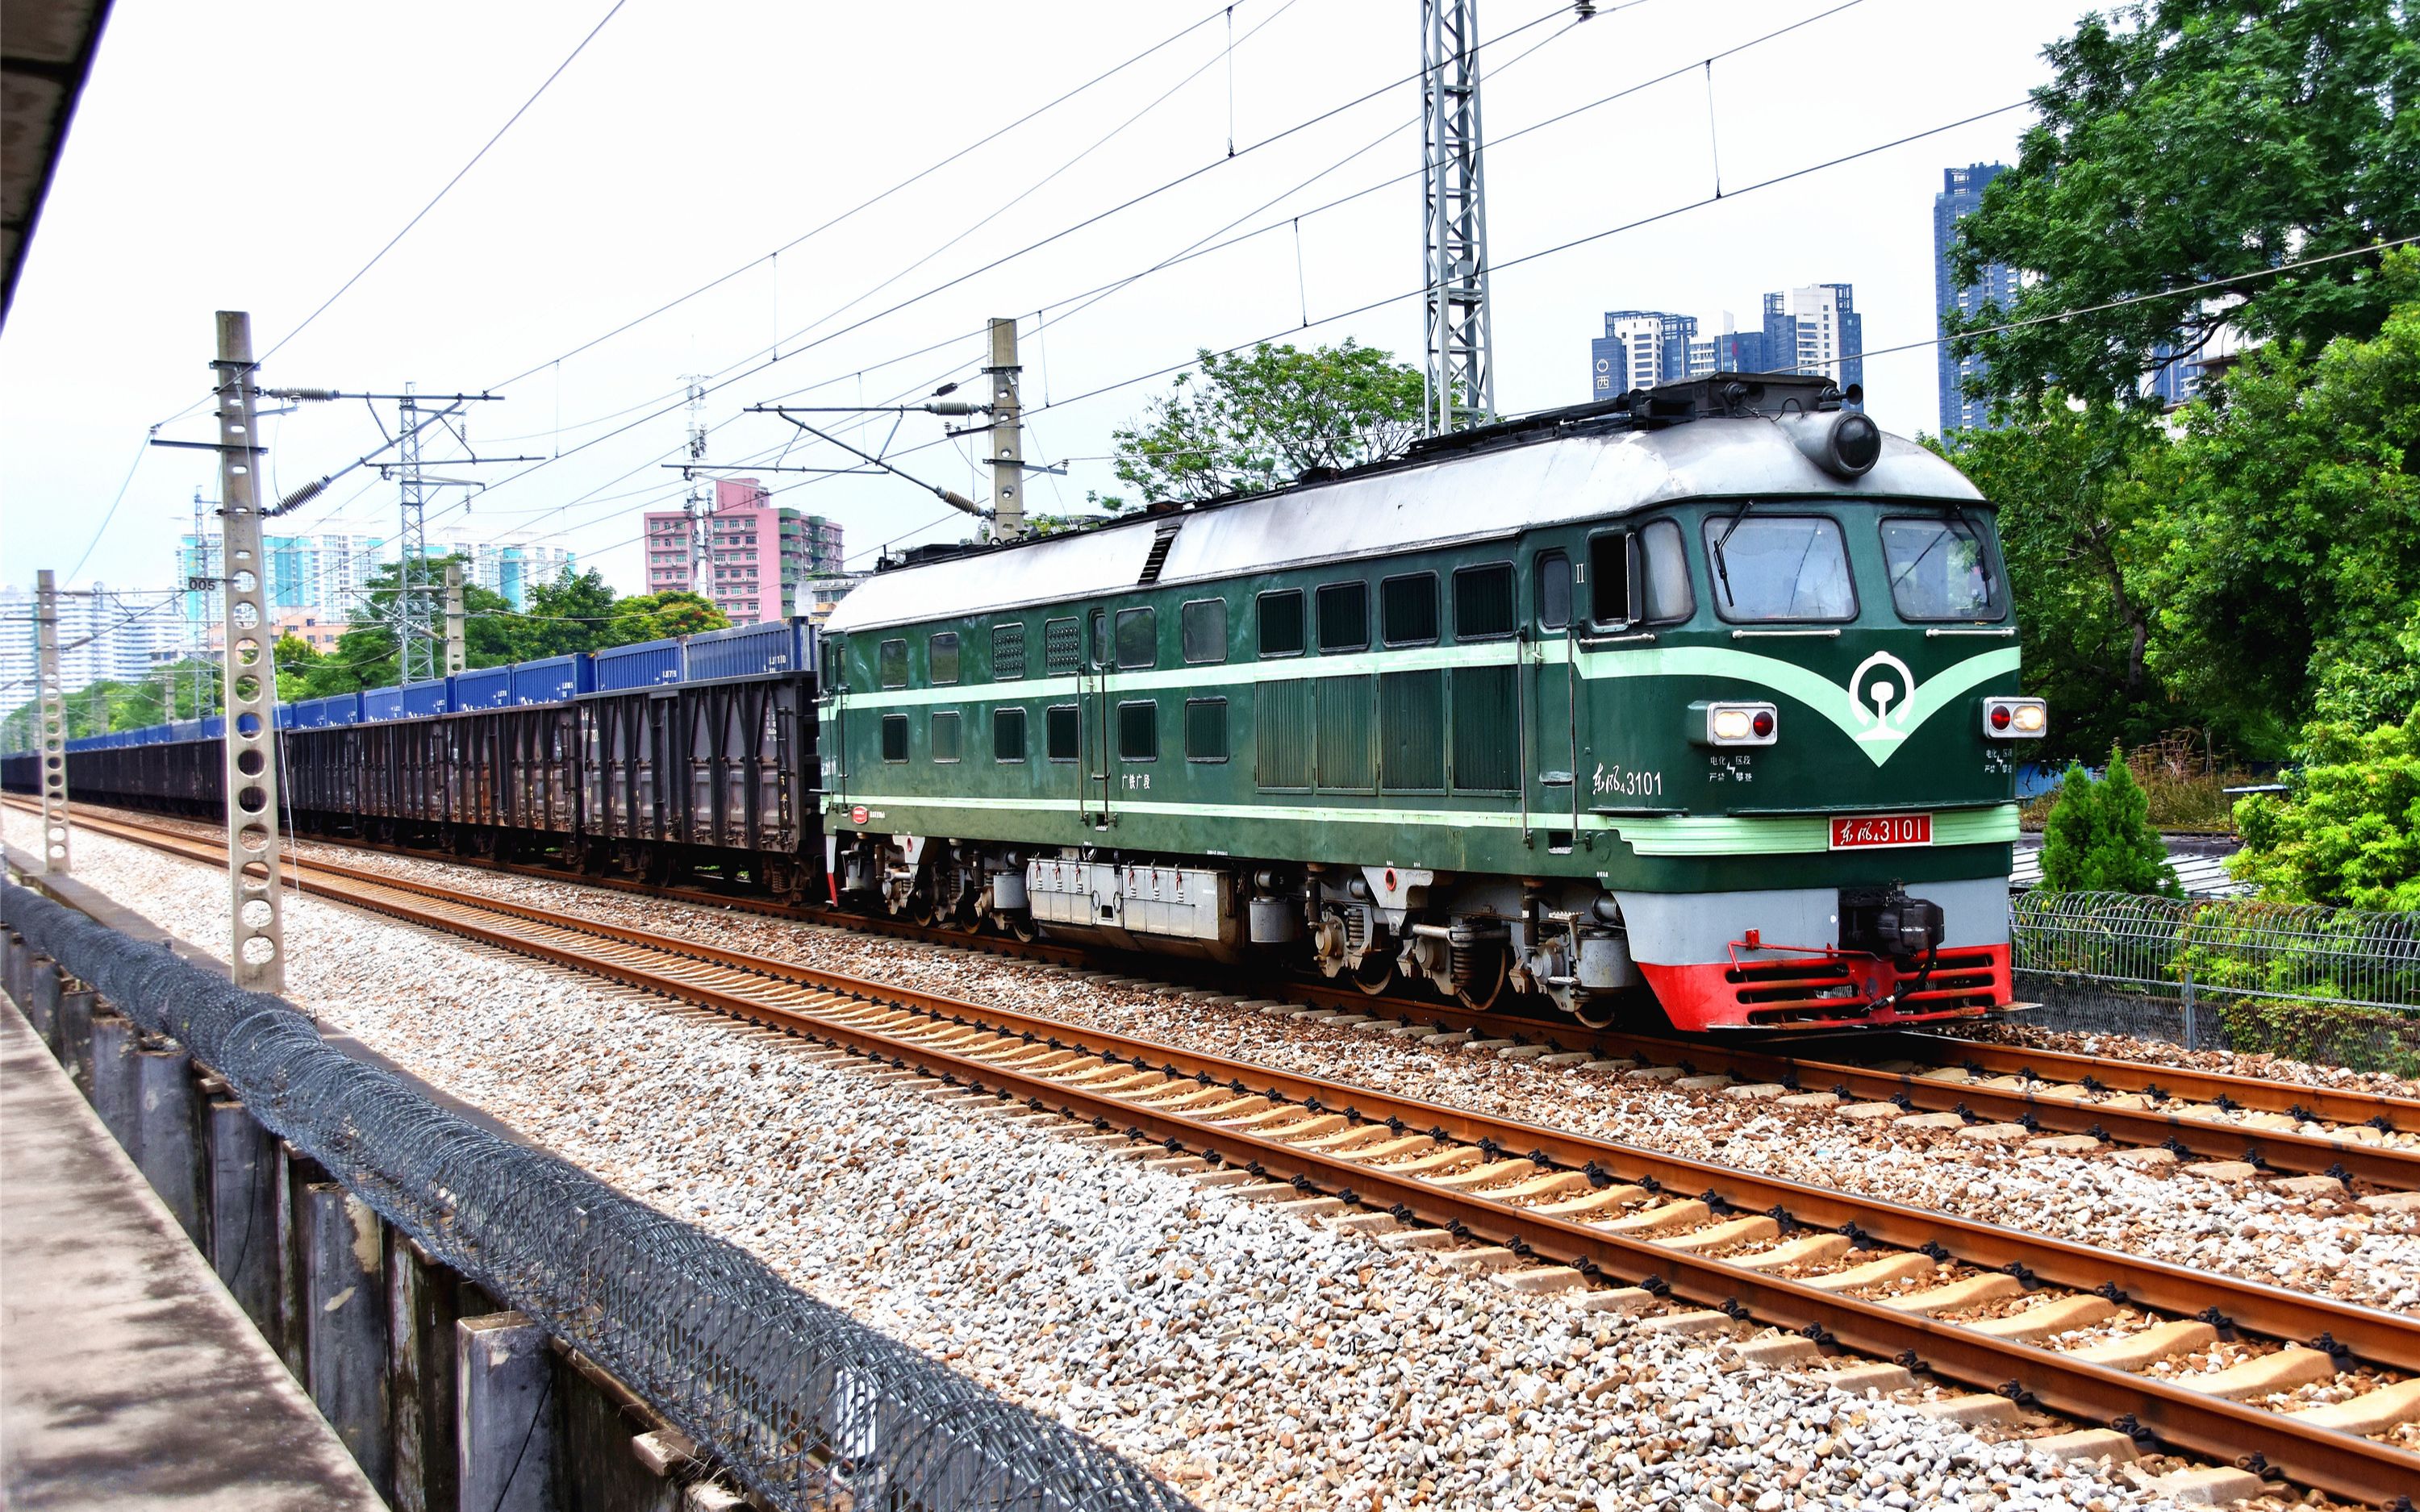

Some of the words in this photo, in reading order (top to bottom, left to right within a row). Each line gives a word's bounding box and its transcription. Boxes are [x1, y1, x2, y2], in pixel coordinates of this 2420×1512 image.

[189, 580, 216, 591] 005
[1710, 756, 1726, 766] 电化
[1735, 755, 1750, 765] 区段
